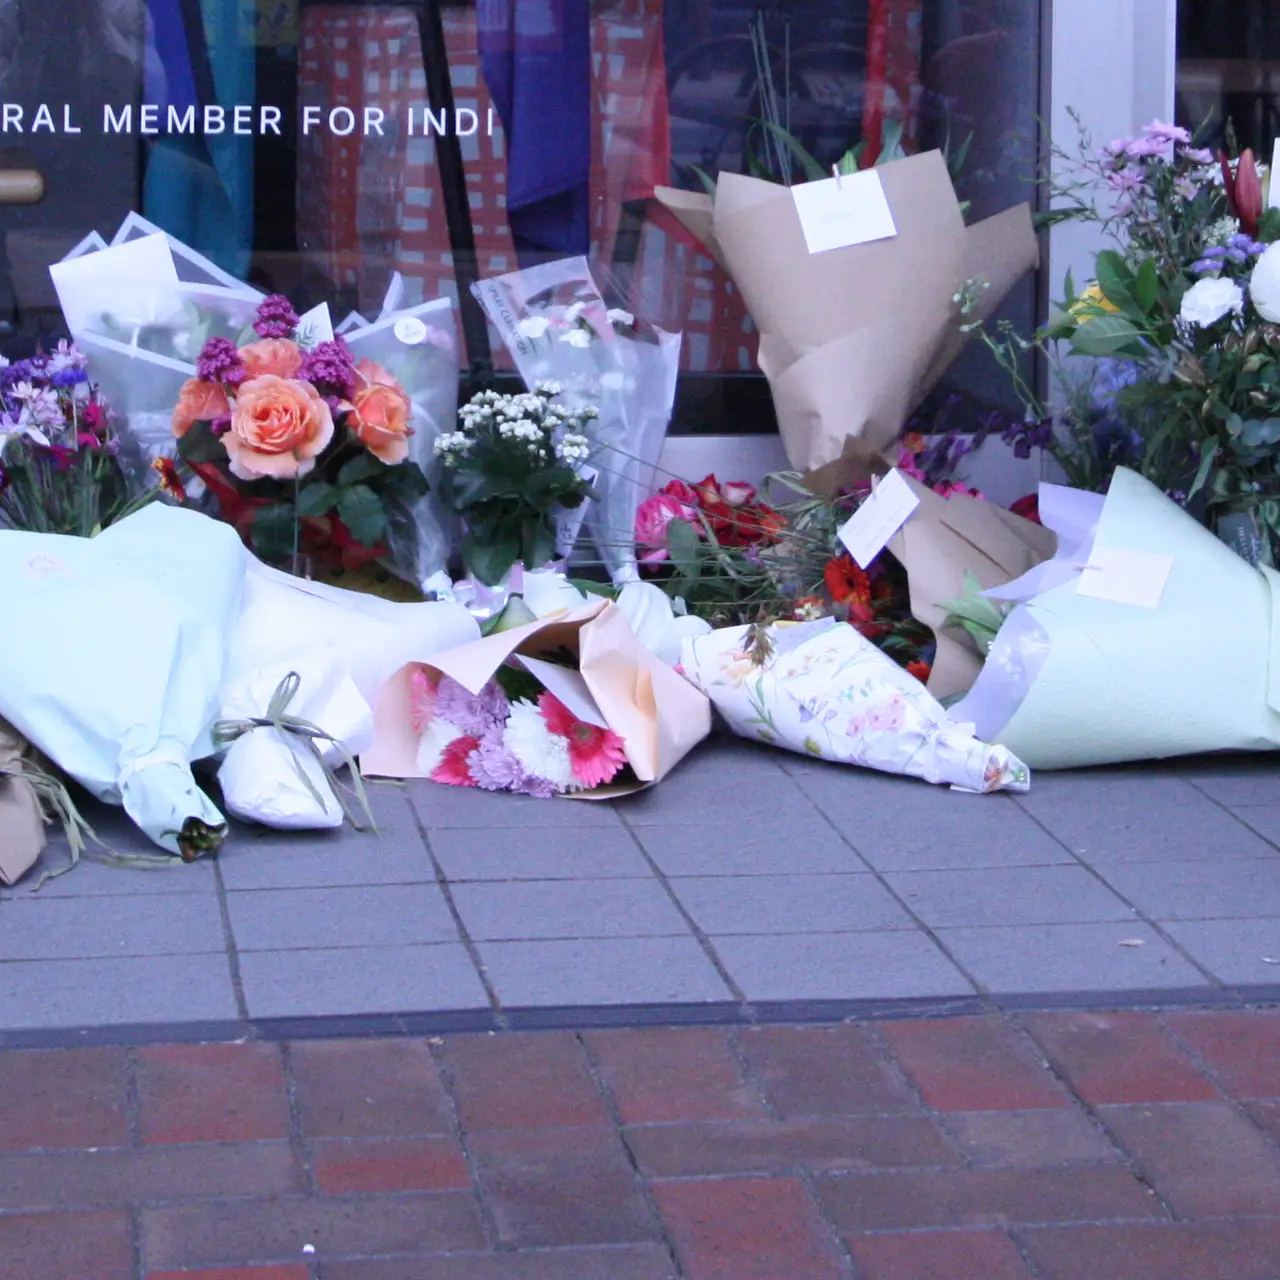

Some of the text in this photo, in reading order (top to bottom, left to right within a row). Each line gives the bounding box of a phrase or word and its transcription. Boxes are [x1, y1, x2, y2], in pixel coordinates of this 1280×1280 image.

[103, 103, 283, 136] MEMBER
[302, 105, 386, 138] FOR
[407, 106, 495, 138] INDI
